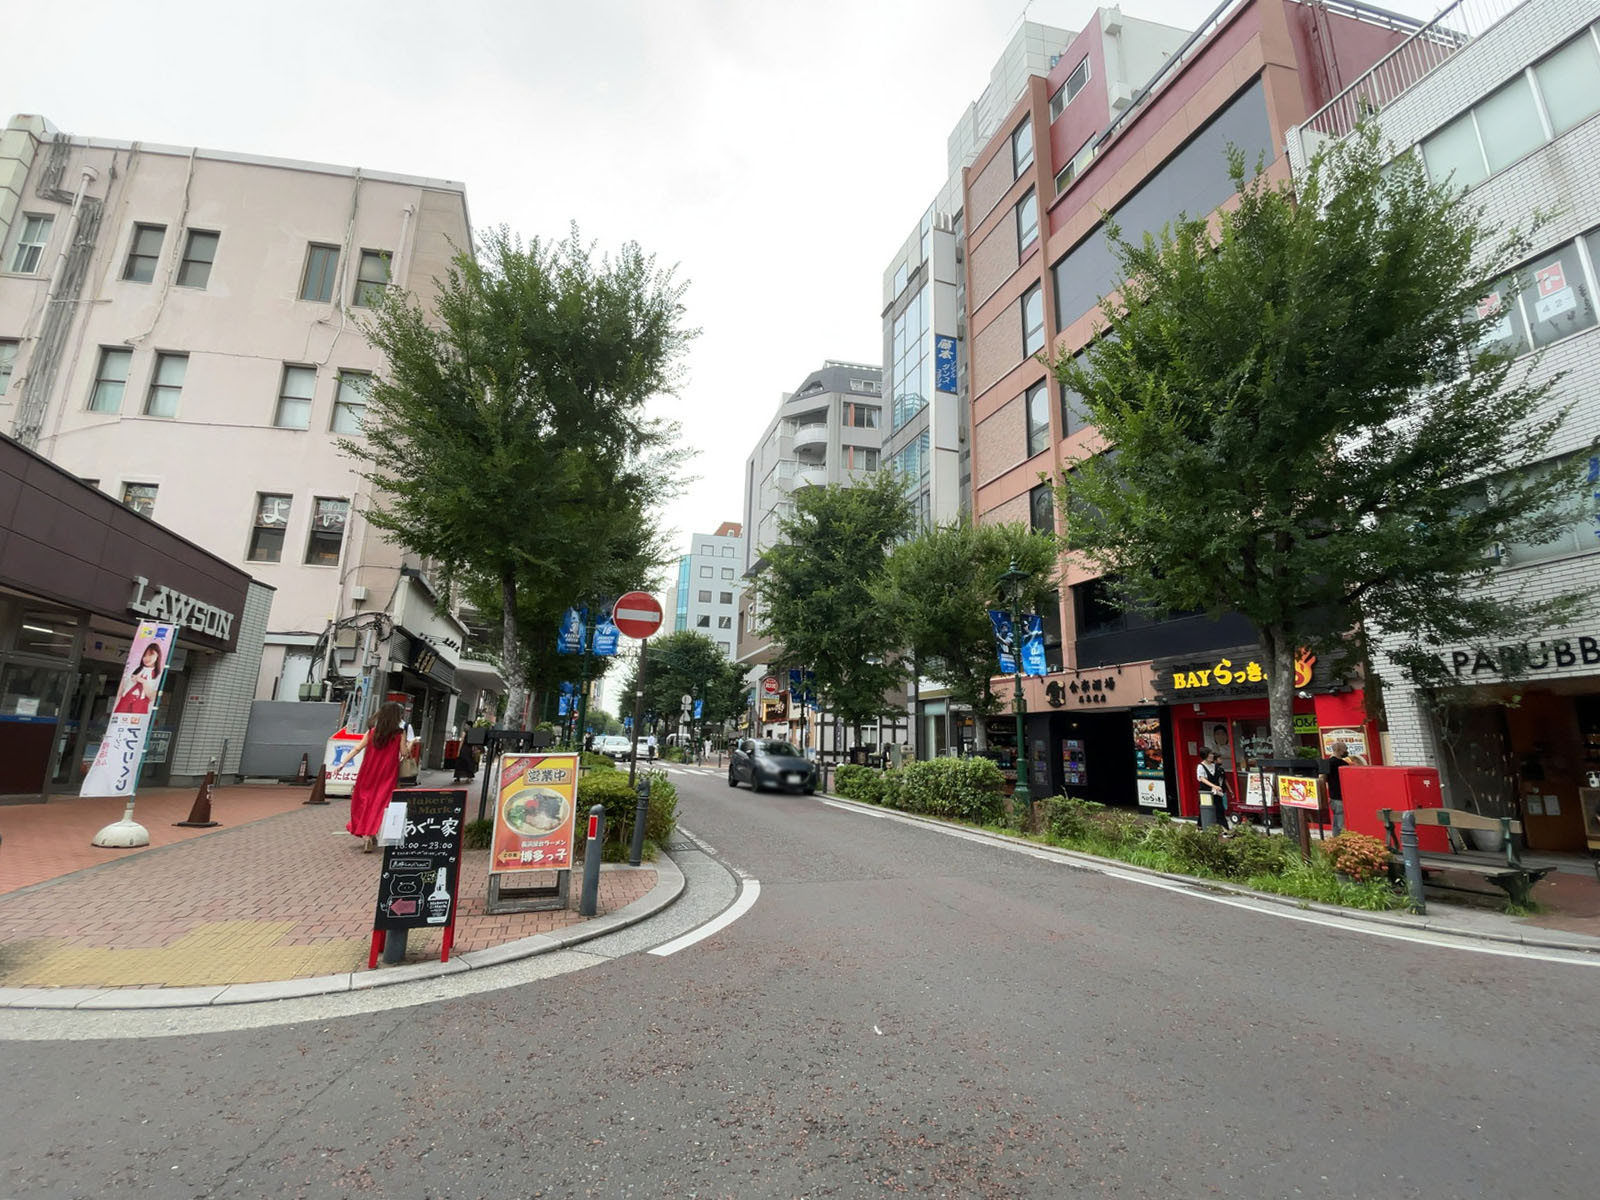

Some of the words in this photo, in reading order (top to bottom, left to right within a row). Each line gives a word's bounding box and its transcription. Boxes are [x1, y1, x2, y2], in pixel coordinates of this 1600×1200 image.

[128, 576, 235, 641] LAWSON
[1213, 658, 1270, 685] らっき
[527, 769, 568, 783] 営業中
[404, 817, 459, 838] あぐー家
[520, 848, 567, 863] 博多っ子
